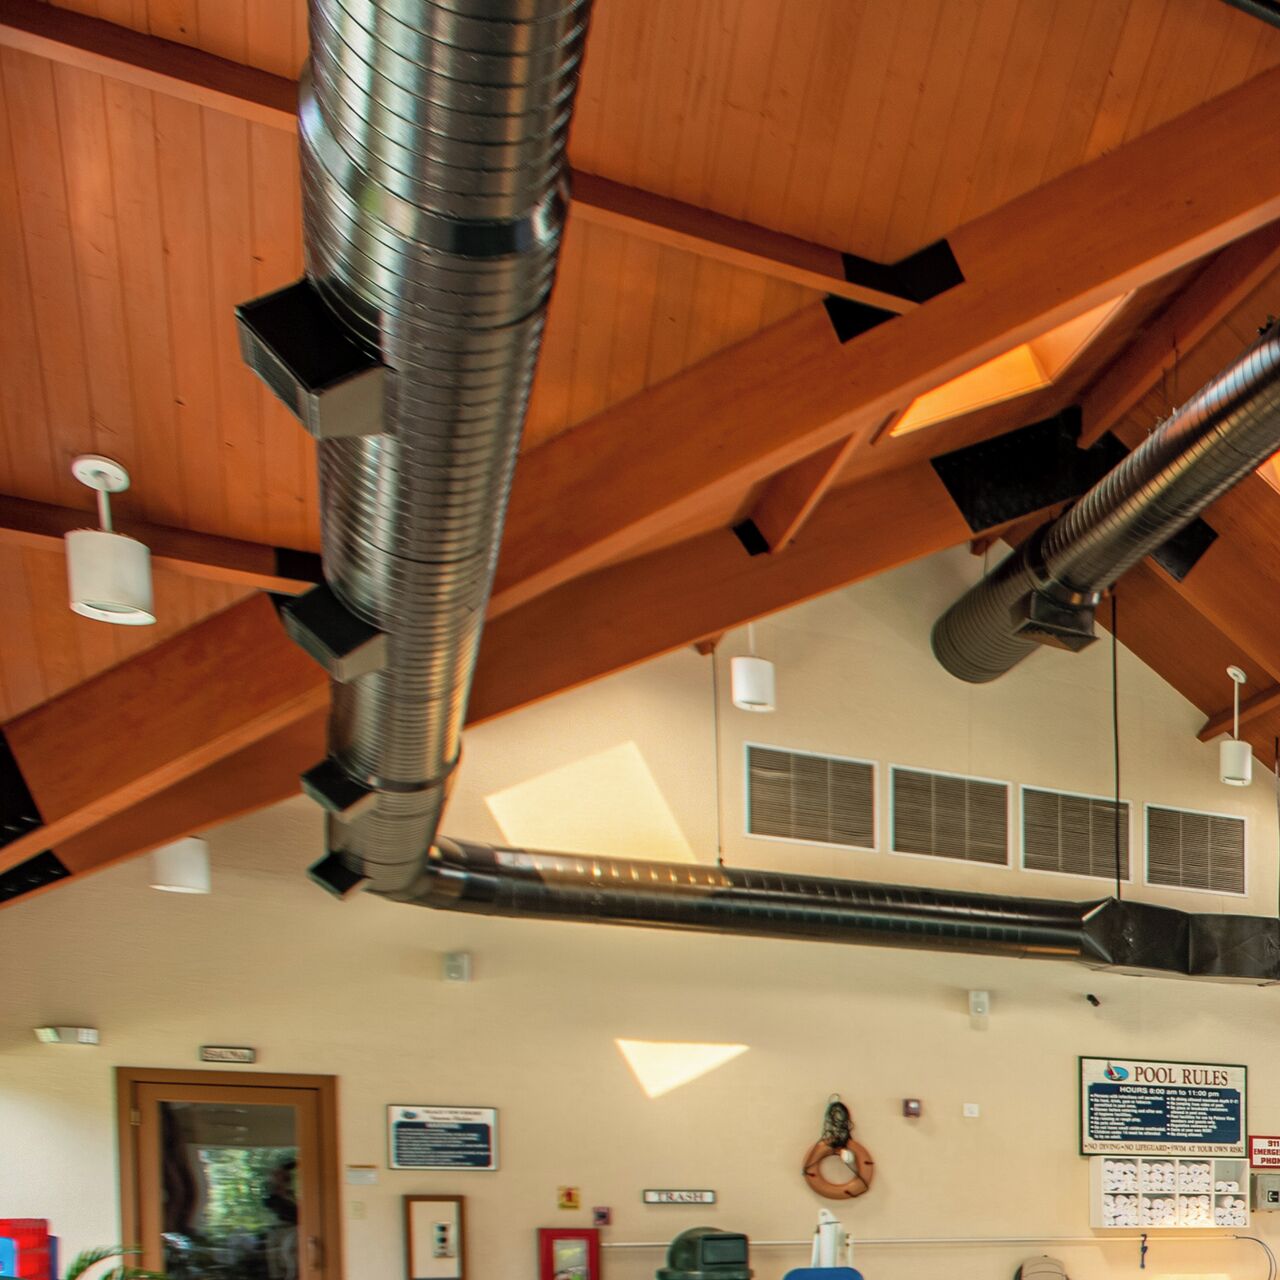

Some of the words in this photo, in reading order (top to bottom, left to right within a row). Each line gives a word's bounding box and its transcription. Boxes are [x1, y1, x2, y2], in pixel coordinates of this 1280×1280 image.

[1134, 1066, 1176, 1084] POOL
[1182, 1069, 1229, 1086] RULES
[1119, 1086, 1148, 1094] HOURS
[1207, 1091, 1220, 1099] pm
[658, 1191, 704, 1202] TRASH
